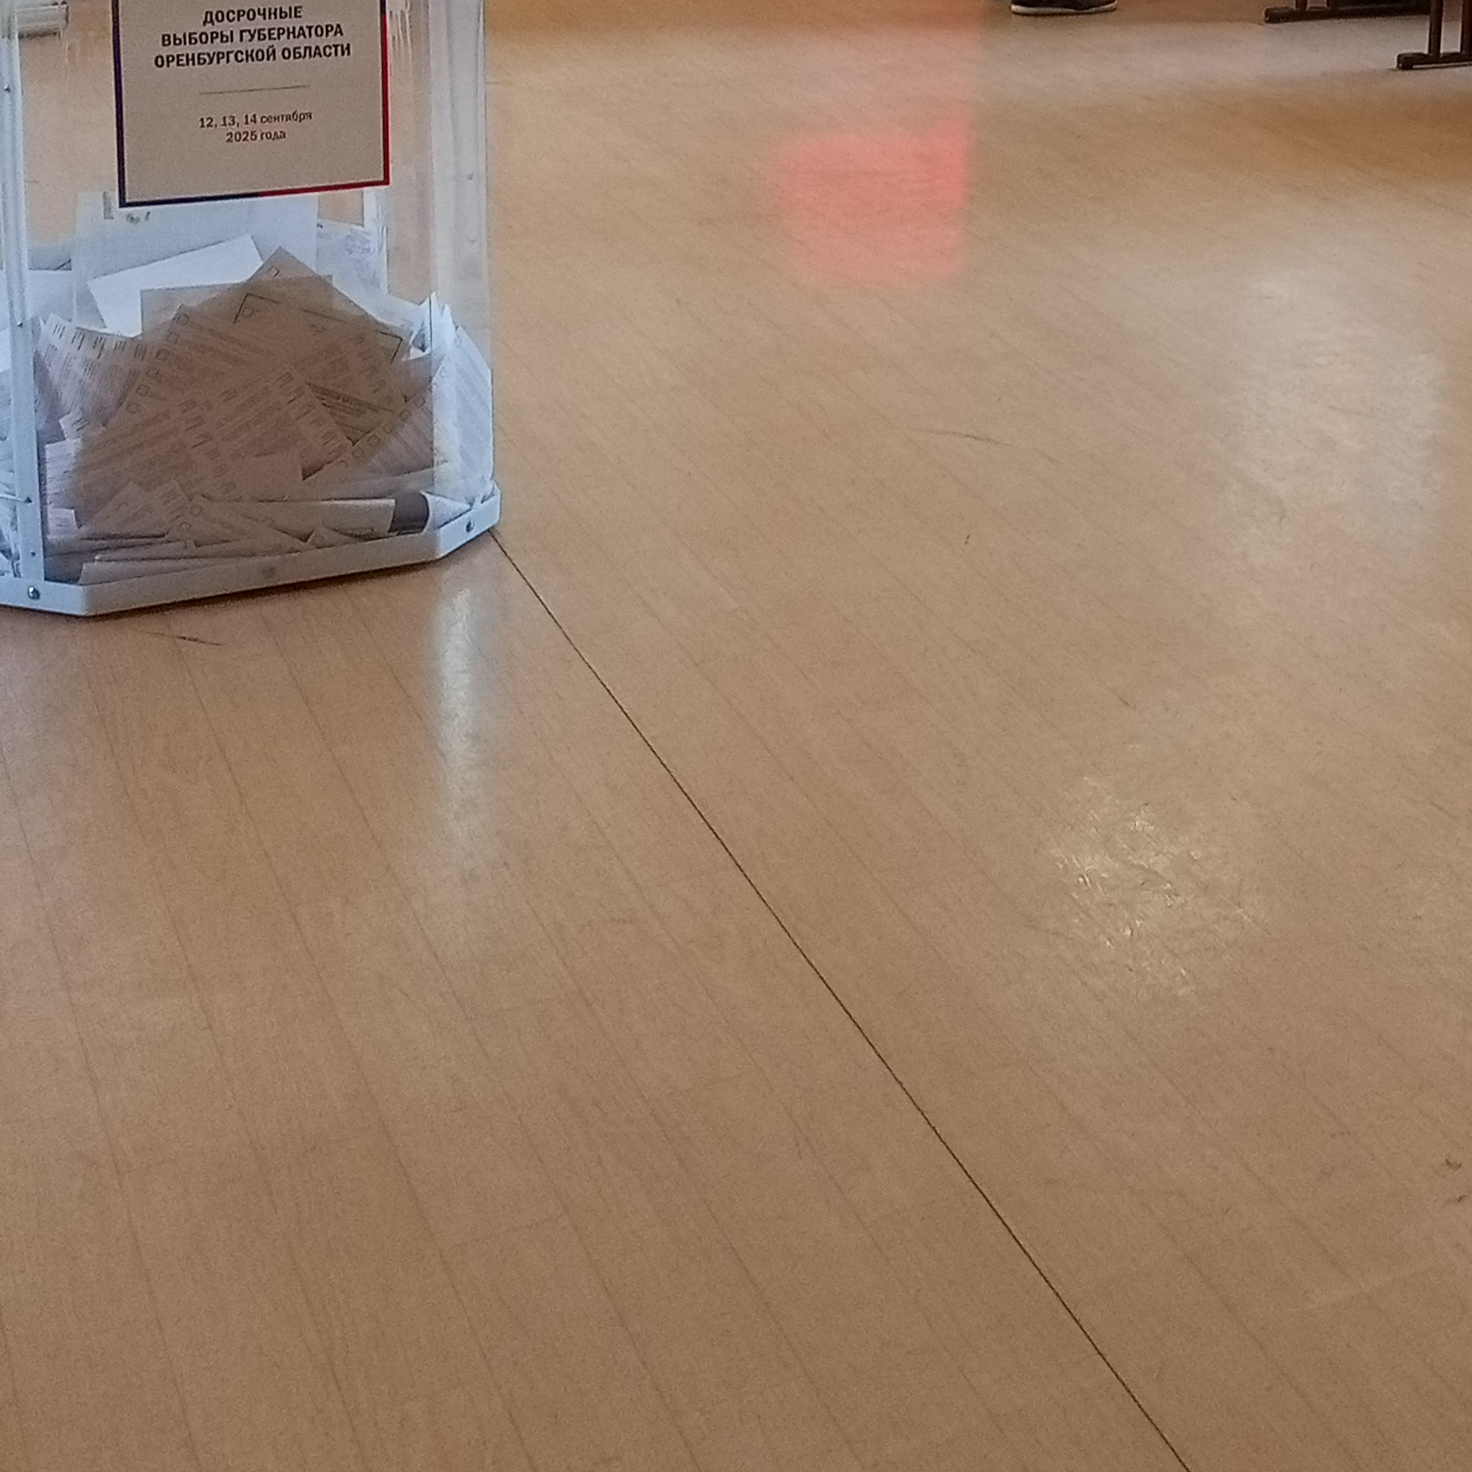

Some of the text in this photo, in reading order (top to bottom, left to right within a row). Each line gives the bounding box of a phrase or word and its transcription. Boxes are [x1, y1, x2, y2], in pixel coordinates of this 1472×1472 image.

[203, 5, 303, 27] ДОСРОЧНЫЕ
[161, 23, 344, 47] ВЫБОРЫ ГУБЕРНАТОРА
[154, 43, 351, 69] ОРЕНБУРГСКОЙ ОБЛАСТИ
[199, 110, 313, 129] 12, 13, 14 сентября
[226, 130, 287, 143] 2025 года
